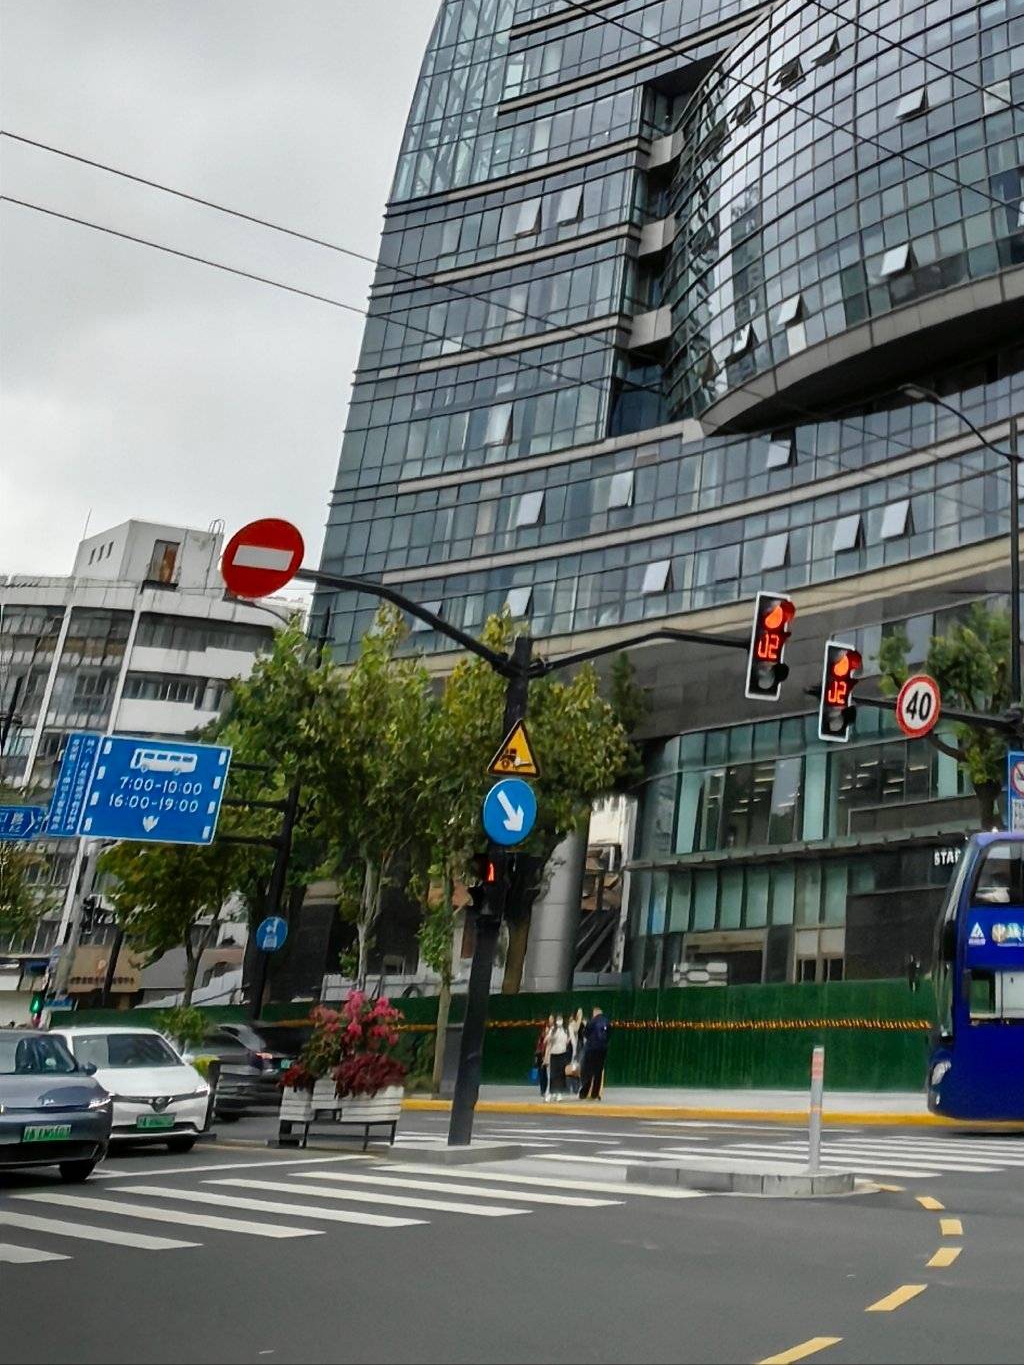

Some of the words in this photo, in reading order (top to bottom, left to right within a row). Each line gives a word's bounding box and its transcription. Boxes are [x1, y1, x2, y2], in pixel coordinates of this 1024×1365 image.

[906, 691, 932, 721] 40
[119, 776, 202, 796] 7:00-10:00
[109, 793, 199, 813] 16:00-19:00
